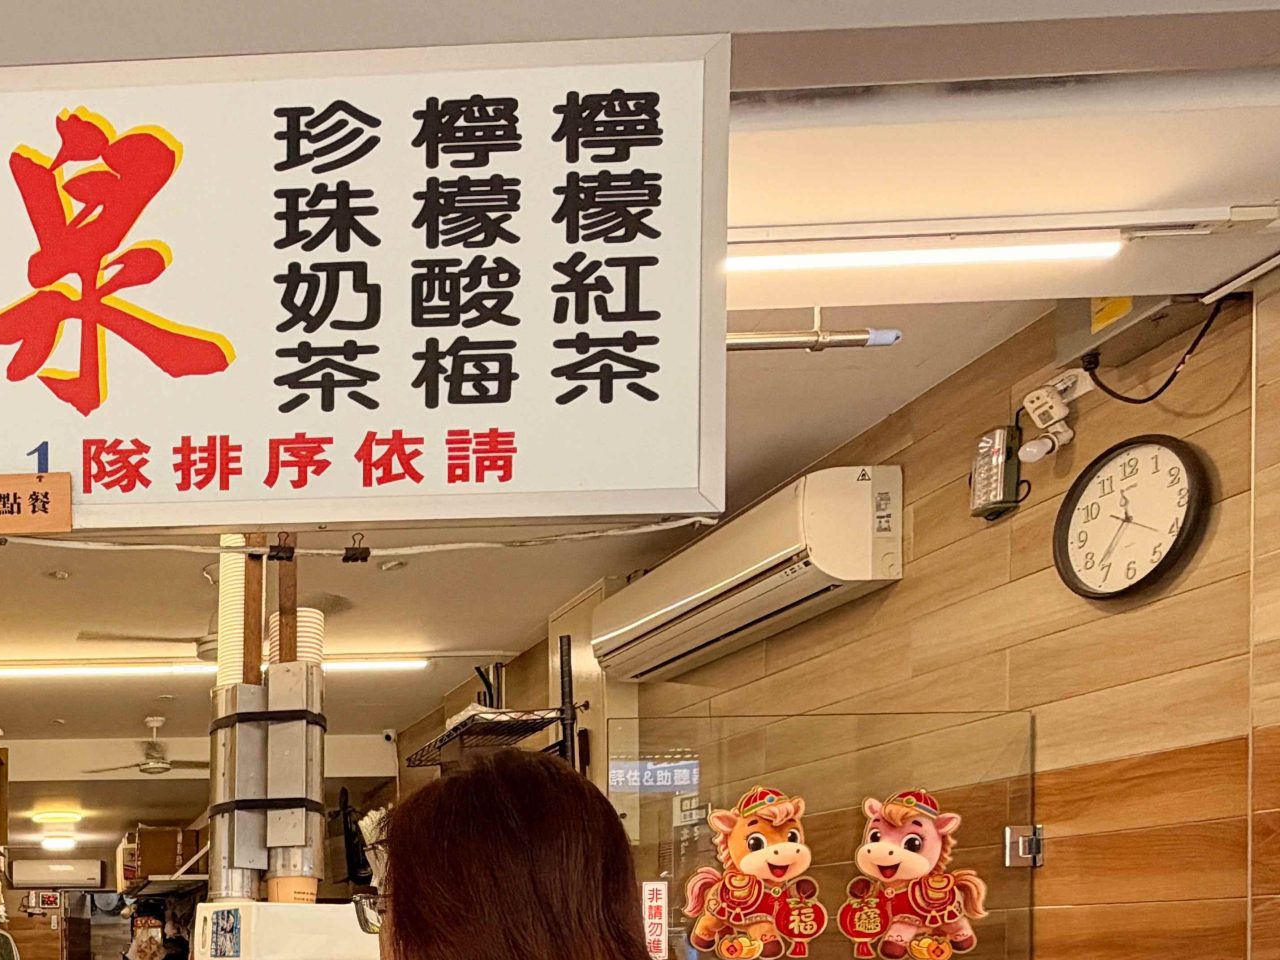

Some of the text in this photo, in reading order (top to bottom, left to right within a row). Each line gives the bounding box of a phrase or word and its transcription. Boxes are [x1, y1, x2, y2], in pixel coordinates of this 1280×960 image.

[274, 100, 382, 413] 珍珠奶茶
[411, 95, 522, 408] 檸檬酸梅
[551, 89, 663, 404] 檸檬紅茶
[1120, 457, 1139, 481] 12
[1150, 454, 1161, 475] 1
[1097, 475, 1115, 499] 11
[1166, 466, 1181, 488] 2
[1082, 501, 1101, 524] 10
[1078, 530, 1088, 549] 9
[1084, 552, 1095, 570] 8
[1150, 542, 1163, 564] 5
[1100, 562, 1112, 583] 7
[1126, 560, 1137, 580] 6
[648, 888, 663, 954] 非請勿進
[788, 908, 817, 934] 福
